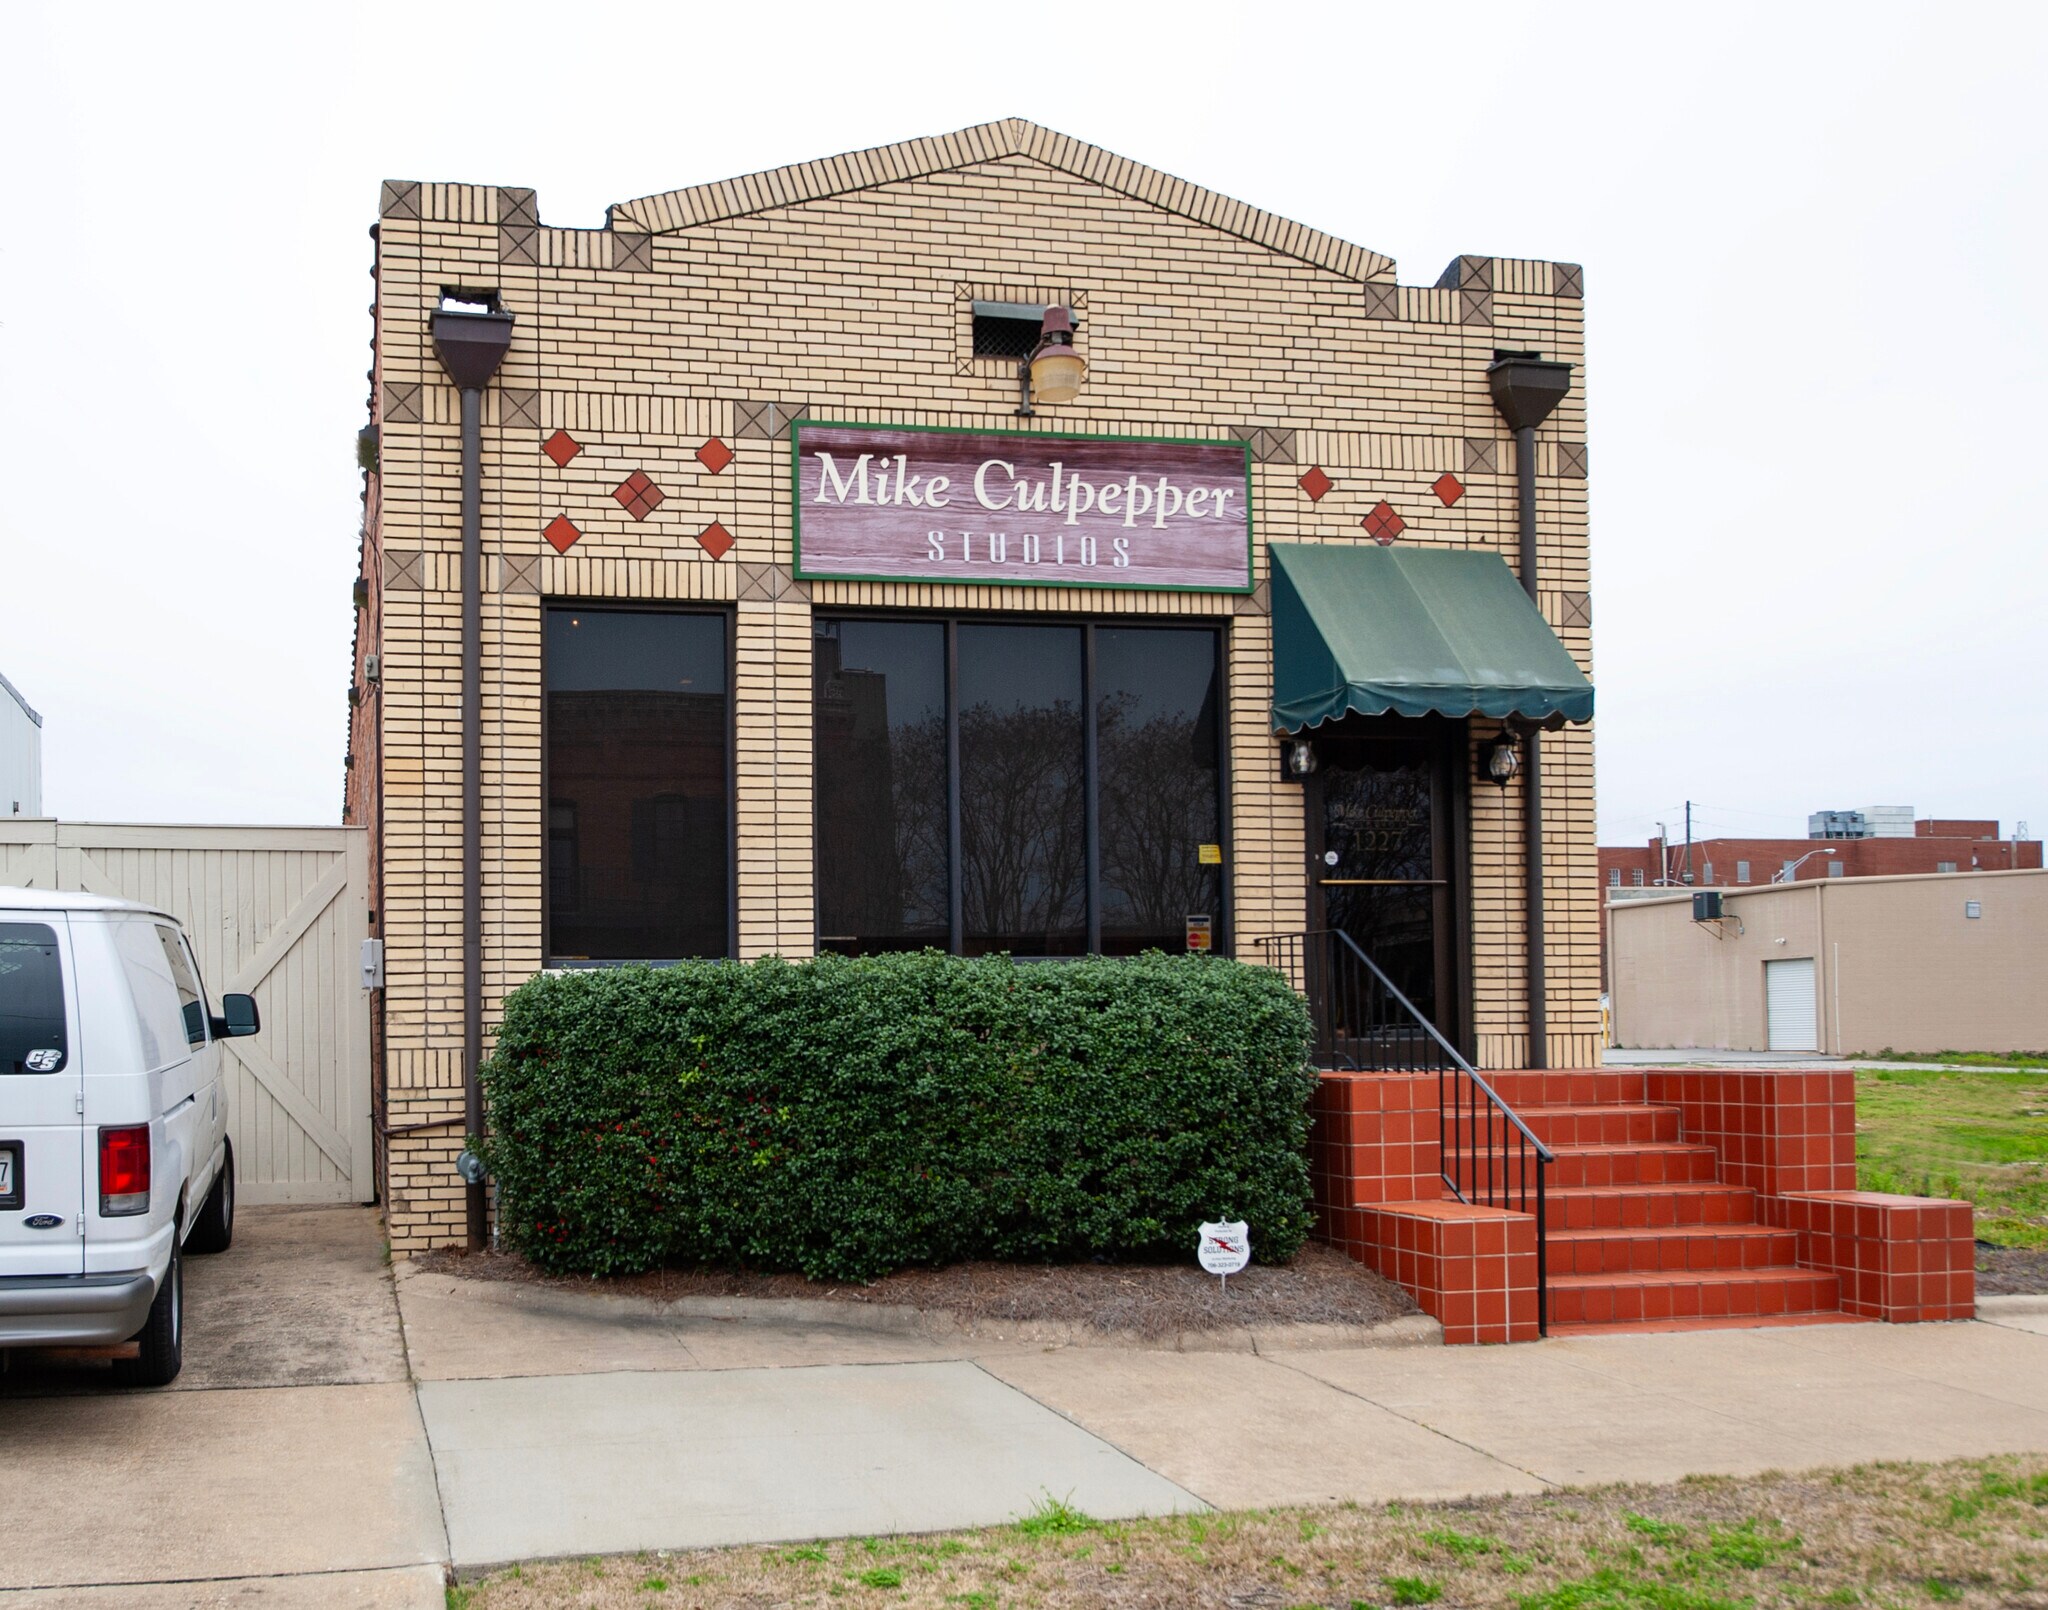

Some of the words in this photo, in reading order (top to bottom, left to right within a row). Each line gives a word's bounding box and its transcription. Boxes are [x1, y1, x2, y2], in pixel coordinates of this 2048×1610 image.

[813, 451, 950, 508] Mike
[973, 458, 1234, 529] Culpepper
[927, 530, 1130, 568] STUDIOS
[1354, 830, 1403, 851] 1227
[32, 1216, 55, 1226] Ford
